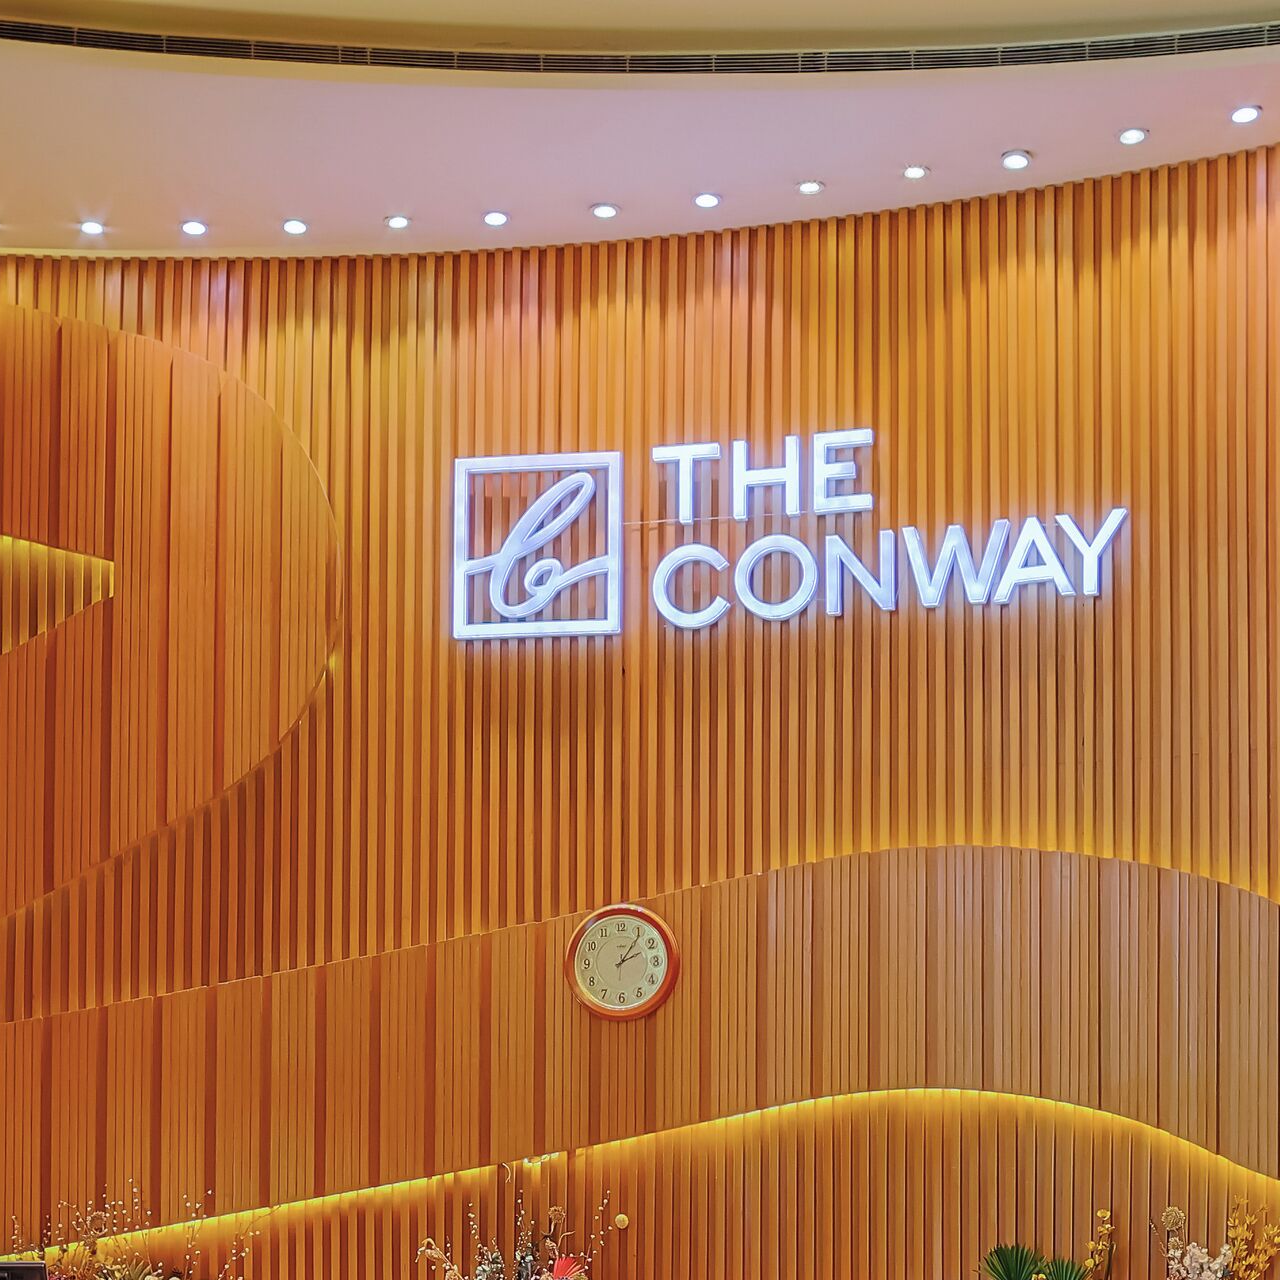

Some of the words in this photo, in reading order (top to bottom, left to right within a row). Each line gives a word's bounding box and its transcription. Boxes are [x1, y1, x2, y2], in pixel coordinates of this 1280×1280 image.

[652, 428, 874, 525] THE
[652, 508, 1127, 630] CONWAY
[616, 923, 625, 931] 12
[600, 929, 607, 937] 11
[588, 942, 596, 951] 10
[647, 939, 656, 950] 2
[583, 959, 591, 969] 9
[652, 956, 660, 967] 3
[588, 977, 595, 987] 8
[648, 974, 656, 985] 4
[600, 989, 608, 1000] 7
[618, 993, 626, 1004] 6
[636, 988, 643, 998] 5
